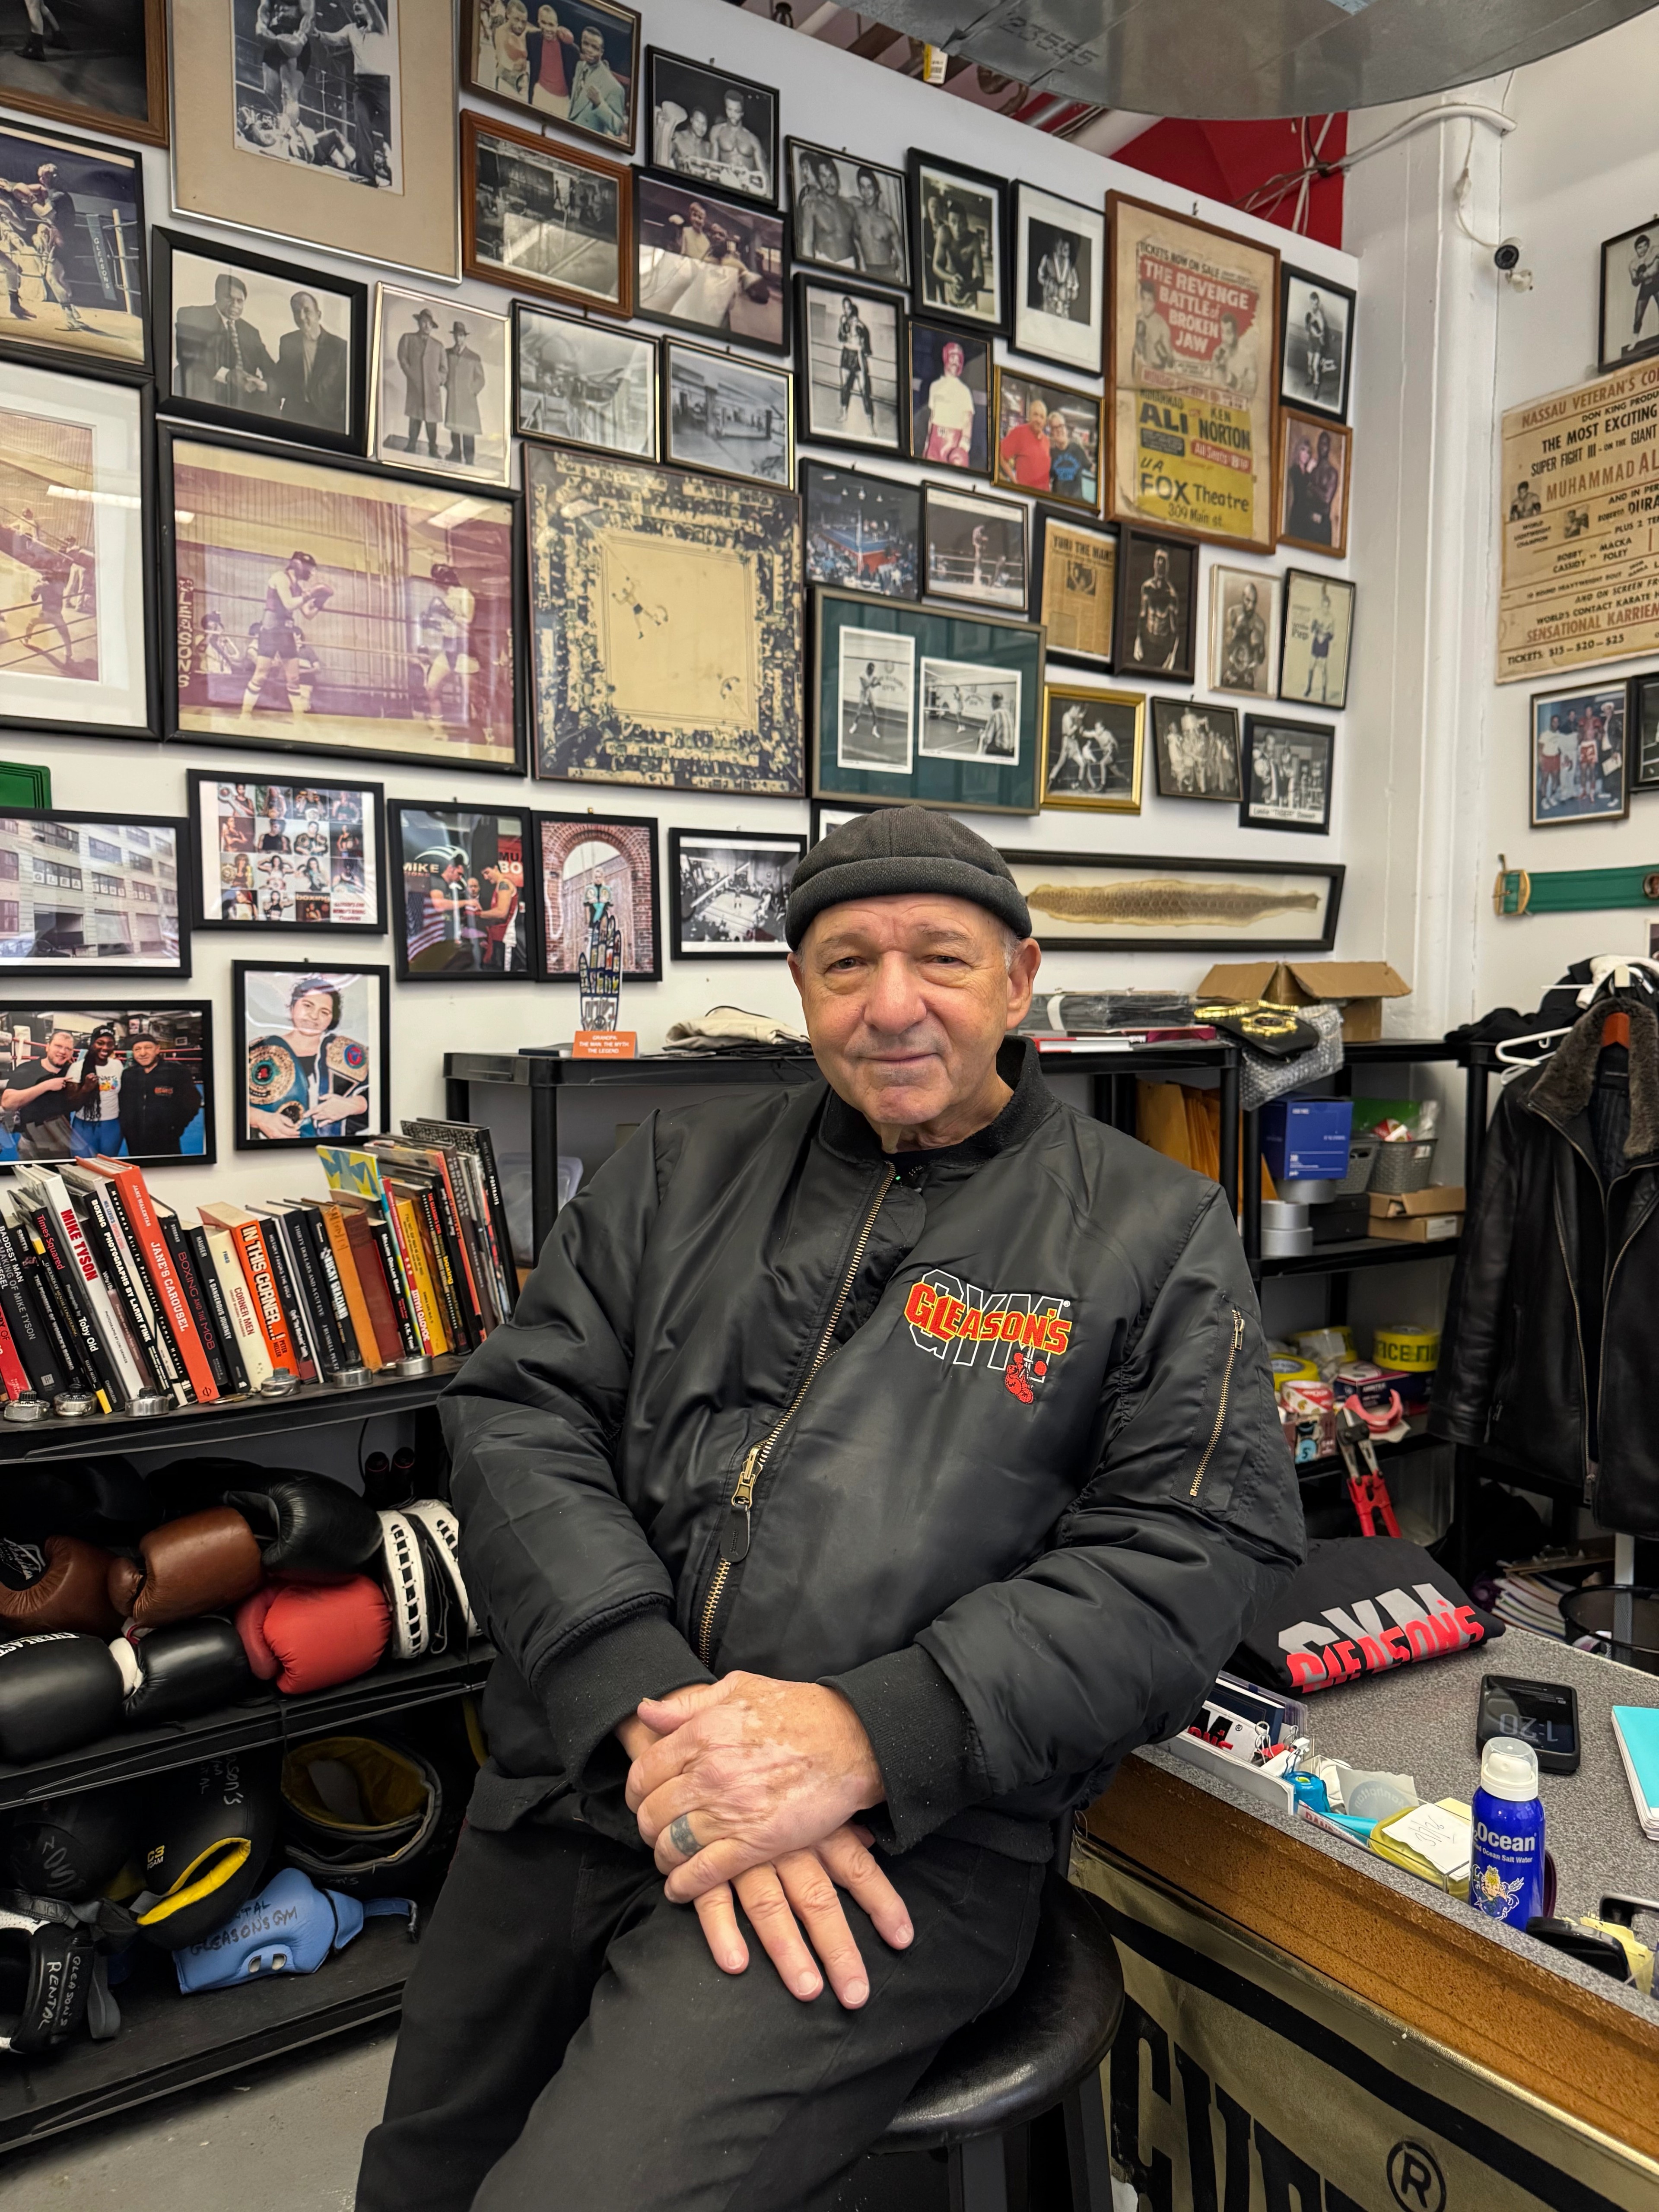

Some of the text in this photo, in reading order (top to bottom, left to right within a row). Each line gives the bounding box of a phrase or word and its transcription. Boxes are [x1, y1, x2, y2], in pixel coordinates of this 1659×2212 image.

[1144, 259, 1173, 286] THE
[1176, 272, 1249, 310] REVENGE
[1202, 264, 1220, 277] SALE
[1159, 286, 1211, 317] BATTLE
[1169, 308, 1219, 338] BROKEN
[1175, 331, 1209, 354] JAW
[1522, 377, 1635, 428] NASSAU VETERAN'S
[1582, 401, 1626, 423] DON KING
[1140, 402, 1231, 435] ALI KEN
[1542, 404, 1658, 454] THE MOST EXCITING
[1199, 418, 1250, 451] NORTON
[1531, 424, 1657, 477] SUPER FIGHT III ON THE GIANT
[1140, 472, 1249, 512] FOX Theatre
[1547, 460, 1634, 502] MUHAMMAD
[1168, 502, 1208, 524] 309 Main
[1608, 493, 1627, 505] AND
[1615, 524, 1634, 534] PLUS
[1553, 549, 1627, 573] CASSIDY FOLEY
[1573, 601, 1612, 617] CONTACT
[1616, 592, 1651, 608] KARATE
[1575, 580, 1643, 604] AND ON SCREEN
[1526, 615, 1602, 643] SENSATIONAL
[489, 1175, 499, 1205] PORTRAITS
[60, 1208, 83, 1241] MIKE
[73, 1241, 99, 1282] TYSON
[239, 1224, 260, 1243] IN
[381, 1233, 393, 1257] MILLION
[90, 1198, 152, 1342] BOXING PHOTOGRAPHS BY LARRY FINK
[131, 1184, 191, 1332] JANE JANE'S CAROUSEL
[244, 1239, 268, 1273] THIS
[293, 1224, 305, 1246] THIRTY
[299, 1246, 313, 1274] DOLLARS
[307, 1273, 317, 1287] AND
[386, 1256, 397, 1279] DOLLAR
[441, 1255, 455, 1285] boxing
[12, 1263, 24, 1283] MAN
[35, 1214, 52, 1238] Times
[44, 1236, 65, 1271] Squared
[76, 1316, 93, 1337] Toby
[85, 1336, 99, 1352] Old
[195, 1236, 208, 1258] HAUSER
[209, 1282, 226, 1316] DANGEROUS
[218, 1315, 232, 1340] JOURNEY
[9, 1280, 36, 1340] OF MIKE TYSON
[16, 1229, 74, 1370] SMITH THE PROMISE OF WOMEN'S BOXING
[177, 1251, 216, 1350] BOXING AND THE MOB
[233, 1287, 255, 1335] CORNER MEN
[330, 1280, 349, 1320] GRAZIANO
[904, 1281, 1071, 1355] GLEASON'S
[910, 1269, 1066, 1382] GYM
[272, 1341, 282, 1358] HELLER
[278, 1339, 288, 1354] PETER
[1500, 1713, 1558, 1742] 1:20
[1473, 1821, 1535, 1852] 2Ocean
[147, 1857, 163, 1870] FOAM
[148, 1845, 165, 1863] C3
[1482, 1847, 1500, 1860] Ocean
[1501, 1854, 1514, 1863] Salt
[272, 1906, 298, 1926] GYM
[38, 1961, 61, 2031] RENTAL
